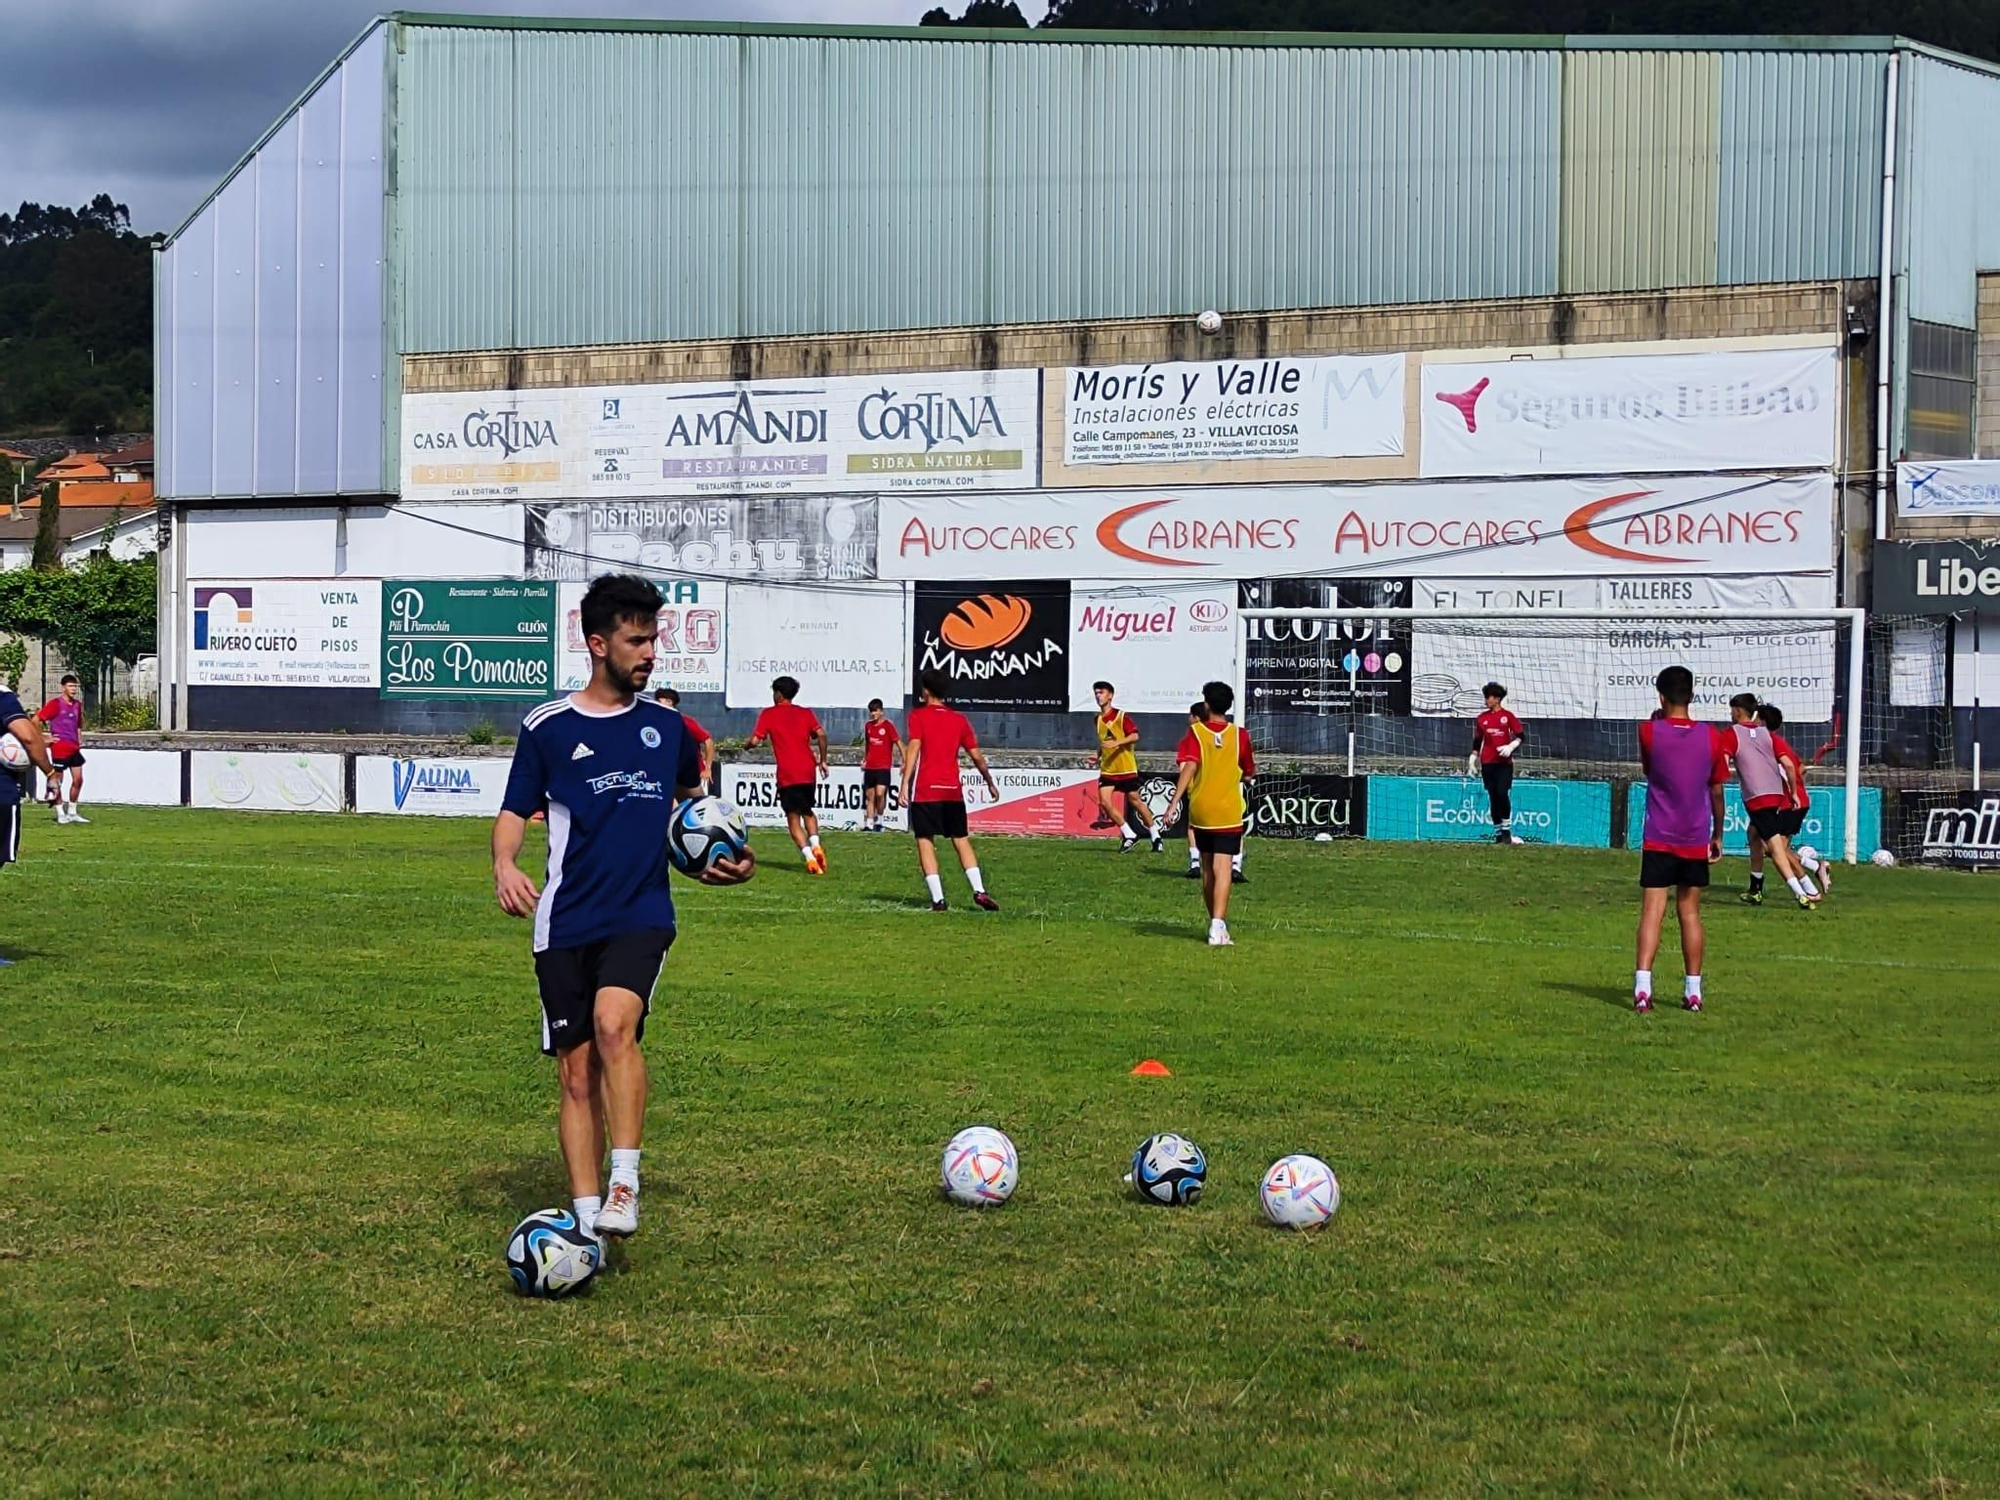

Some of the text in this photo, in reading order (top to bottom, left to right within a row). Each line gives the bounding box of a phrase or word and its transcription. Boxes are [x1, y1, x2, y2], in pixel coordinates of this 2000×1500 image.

[1073, 361, 1300, 405] Morís y Valle
[665, 390, 828, 446] AMANDI
[858, 386, 1007, 453] CORTINA
[1073, 400, 1299, 425] Instalaciones eléctricas
[414, 408, 558, 460] CASA CORTINA
[1073, 431, 1099, 442] Calle
[1103, 430, 1177, 442] Campomanes,
[1182, 427, 1196, 438] 23
[1209, 424, 1299, 437] VILLAVICIOSA
[683, 459, 810, 474] RESTAURANTE
[871, 454, 994, 470] SIDRA NATURAL
[592, 507, 728, 527] DISTRIBUCIONES
[900, 490, 1803, 566] AUTOCARES CABRANES AUTOCARES CABRANES
[321, 592, 358, 605] VENTA
[1609, 582, 1692, 600] TALLERES
[332, 616, 348, 628] DE
[800, 622, 839, 630] RENAULT
[1078, 605, 1177, 641] Miguel
[210, 636, 297, 651] RIVERO CUETO
[321, 639, 358, 652] PISOS
[924, 630, 939, 650] LA
[1682, 632, 1712, 649] S.L.
[1733, 636, 1820, 646] PEUGEOT
[387, 641, 548, 685] Los Pomares
[735, 657, 896, 675] JOSÉ RAMÓN VILLAR, S.L.
[920, 638, 1063, 680] MARIÑANA
[1247, 658, 1338, 668] IMPRENTA DIGITAL
[1608, 675, 1821, 688] SERVIC FICIAL PEUGEOT
[996, 775, 1001, 786] Y
[1004, 776, 1062, 787] ESCOLLERAS
[813, 784, 899, 811] ILAGS
[1463, 795, 1473, 809] el
[1725, 803, 1738, 816] el
[1954, 849, 1978, 859] TODOS
